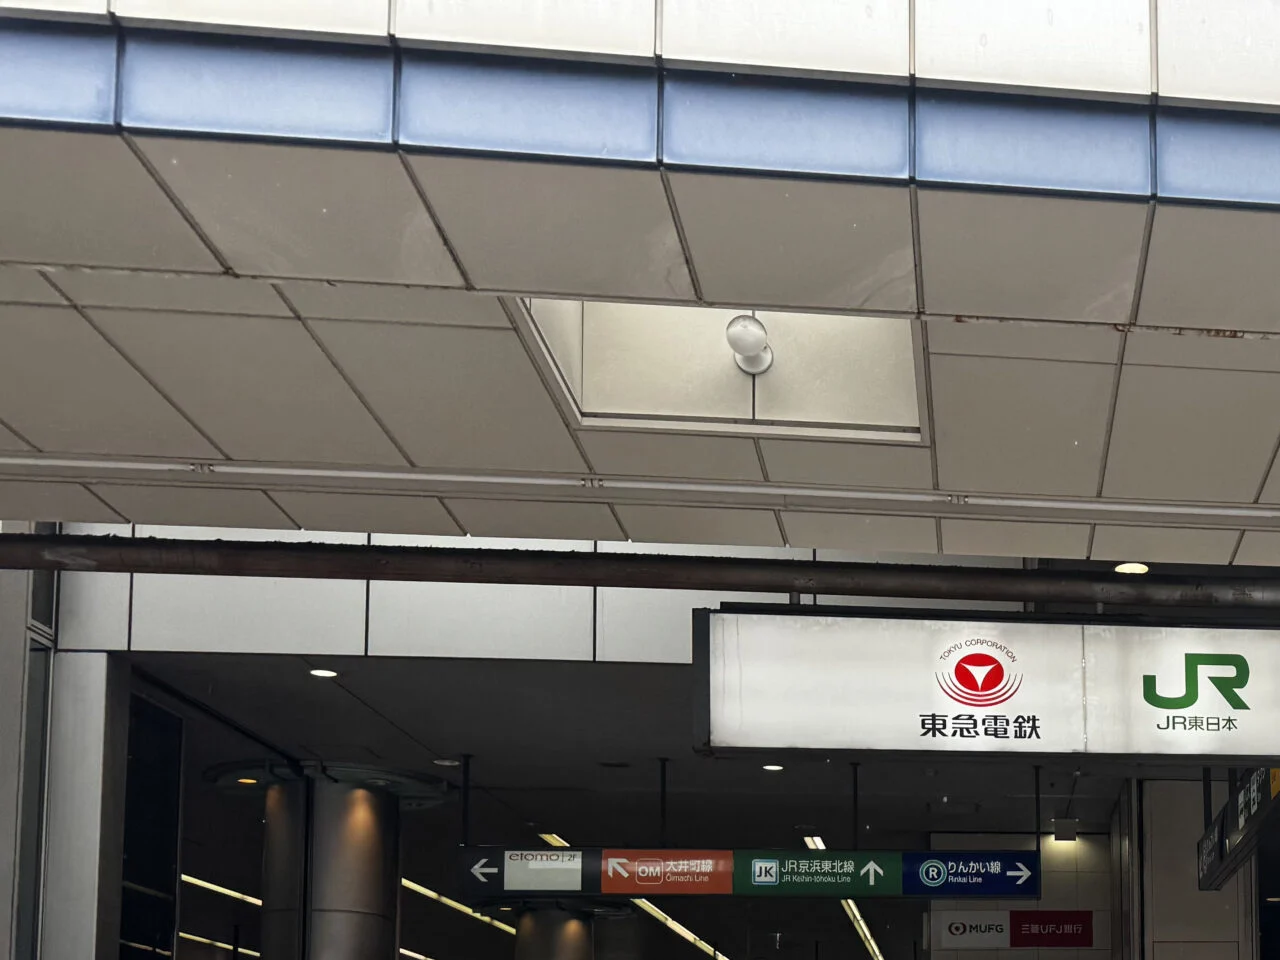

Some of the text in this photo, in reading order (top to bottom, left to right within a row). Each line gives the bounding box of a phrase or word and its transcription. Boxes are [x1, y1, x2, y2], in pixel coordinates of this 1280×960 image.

[940, 639, 1017, 663] TOKYU CORPORATION
[1143, 653, 1251, 710] JR
[919, 713, 1041, 739] 東急電鉄
[1156, 715, 1238, 731] JR東日本
[509, 852, 559, 862] etomo
[638, 865, 661, 877] OM
[666, 860, 713, 872] 大井町線
[756, 866, 774, 877] JK
[781, 860, 855, 873] JR京浜東北線
[948, 861, 1000, 874] りんかい線
[929, 867, 938, 879] R
[969, 924, 1004, 933] MUFG
